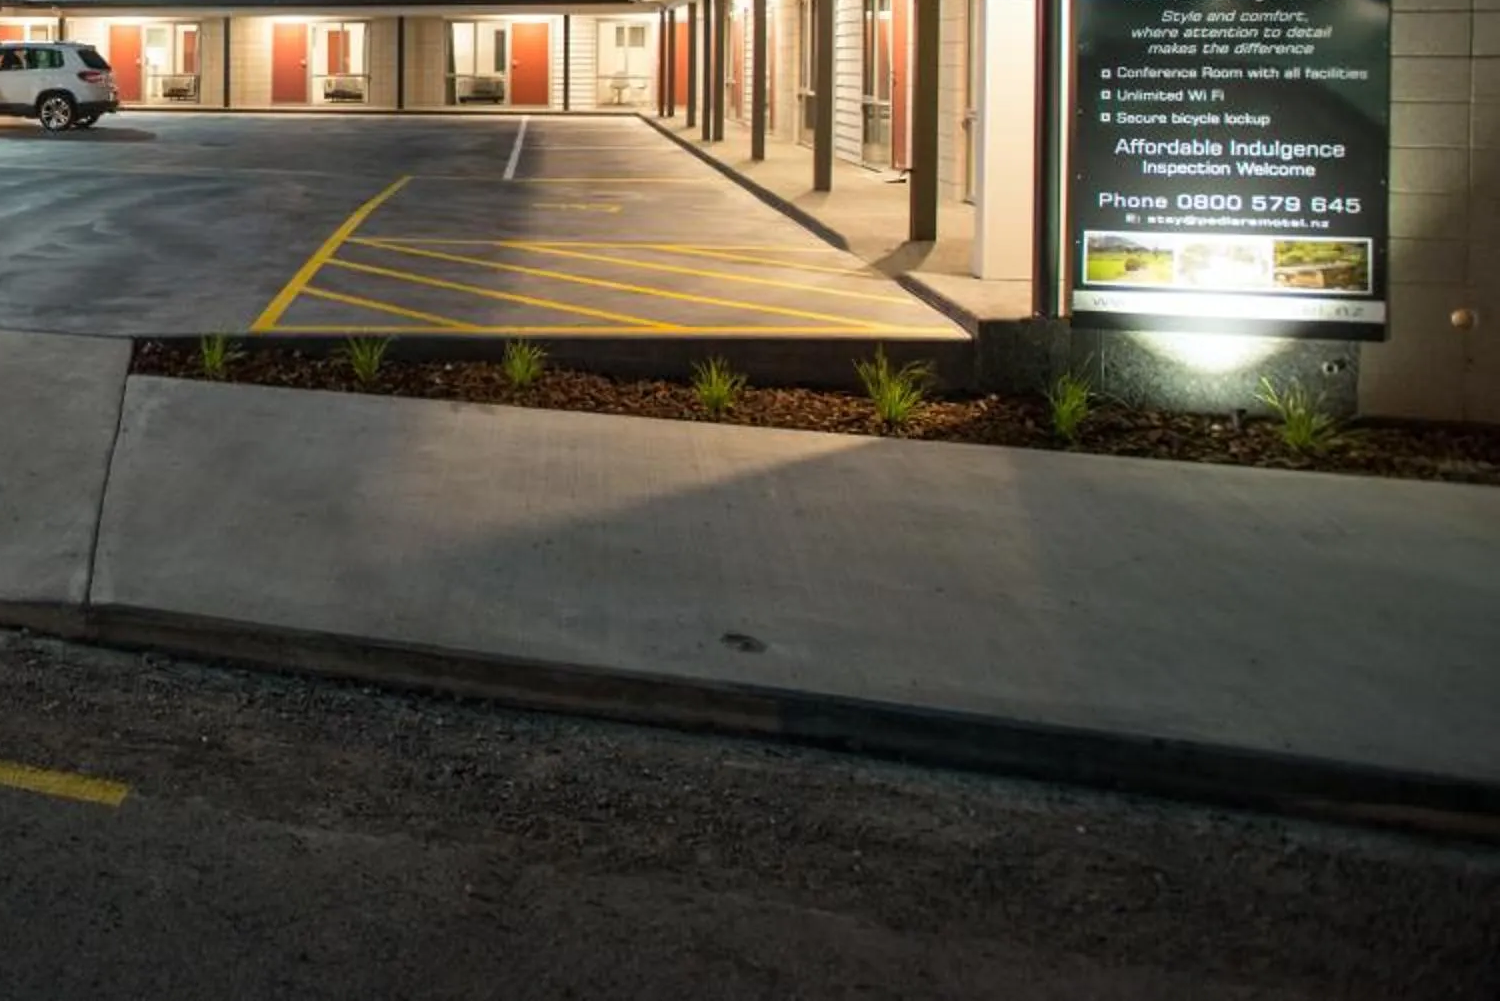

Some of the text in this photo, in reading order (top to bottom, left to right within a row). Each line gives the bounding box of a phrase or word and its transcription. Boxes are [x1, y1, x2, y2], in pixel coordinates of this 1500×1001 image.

[1161, 10, 1202, 23] Style
[1207, 10, 1235, 21] and
[1131, 26, 1333, 38] where attention to detail
[1148, 43, 1316, 54] makes the difference
[1117, 67, 1369, 79] Conference Room with all facilities
[1117, 89, 1225, 101] Unlimited Wi Fi
[1117, 113, 1271, 127] Secure bicycle lockup
[1115, 139, 1346, 159] Affordable Indulgence
[1143, 161, 1316, 177] Inspection Welcome
[1099, 193, 1362, 214] Phone 0800 579 645
